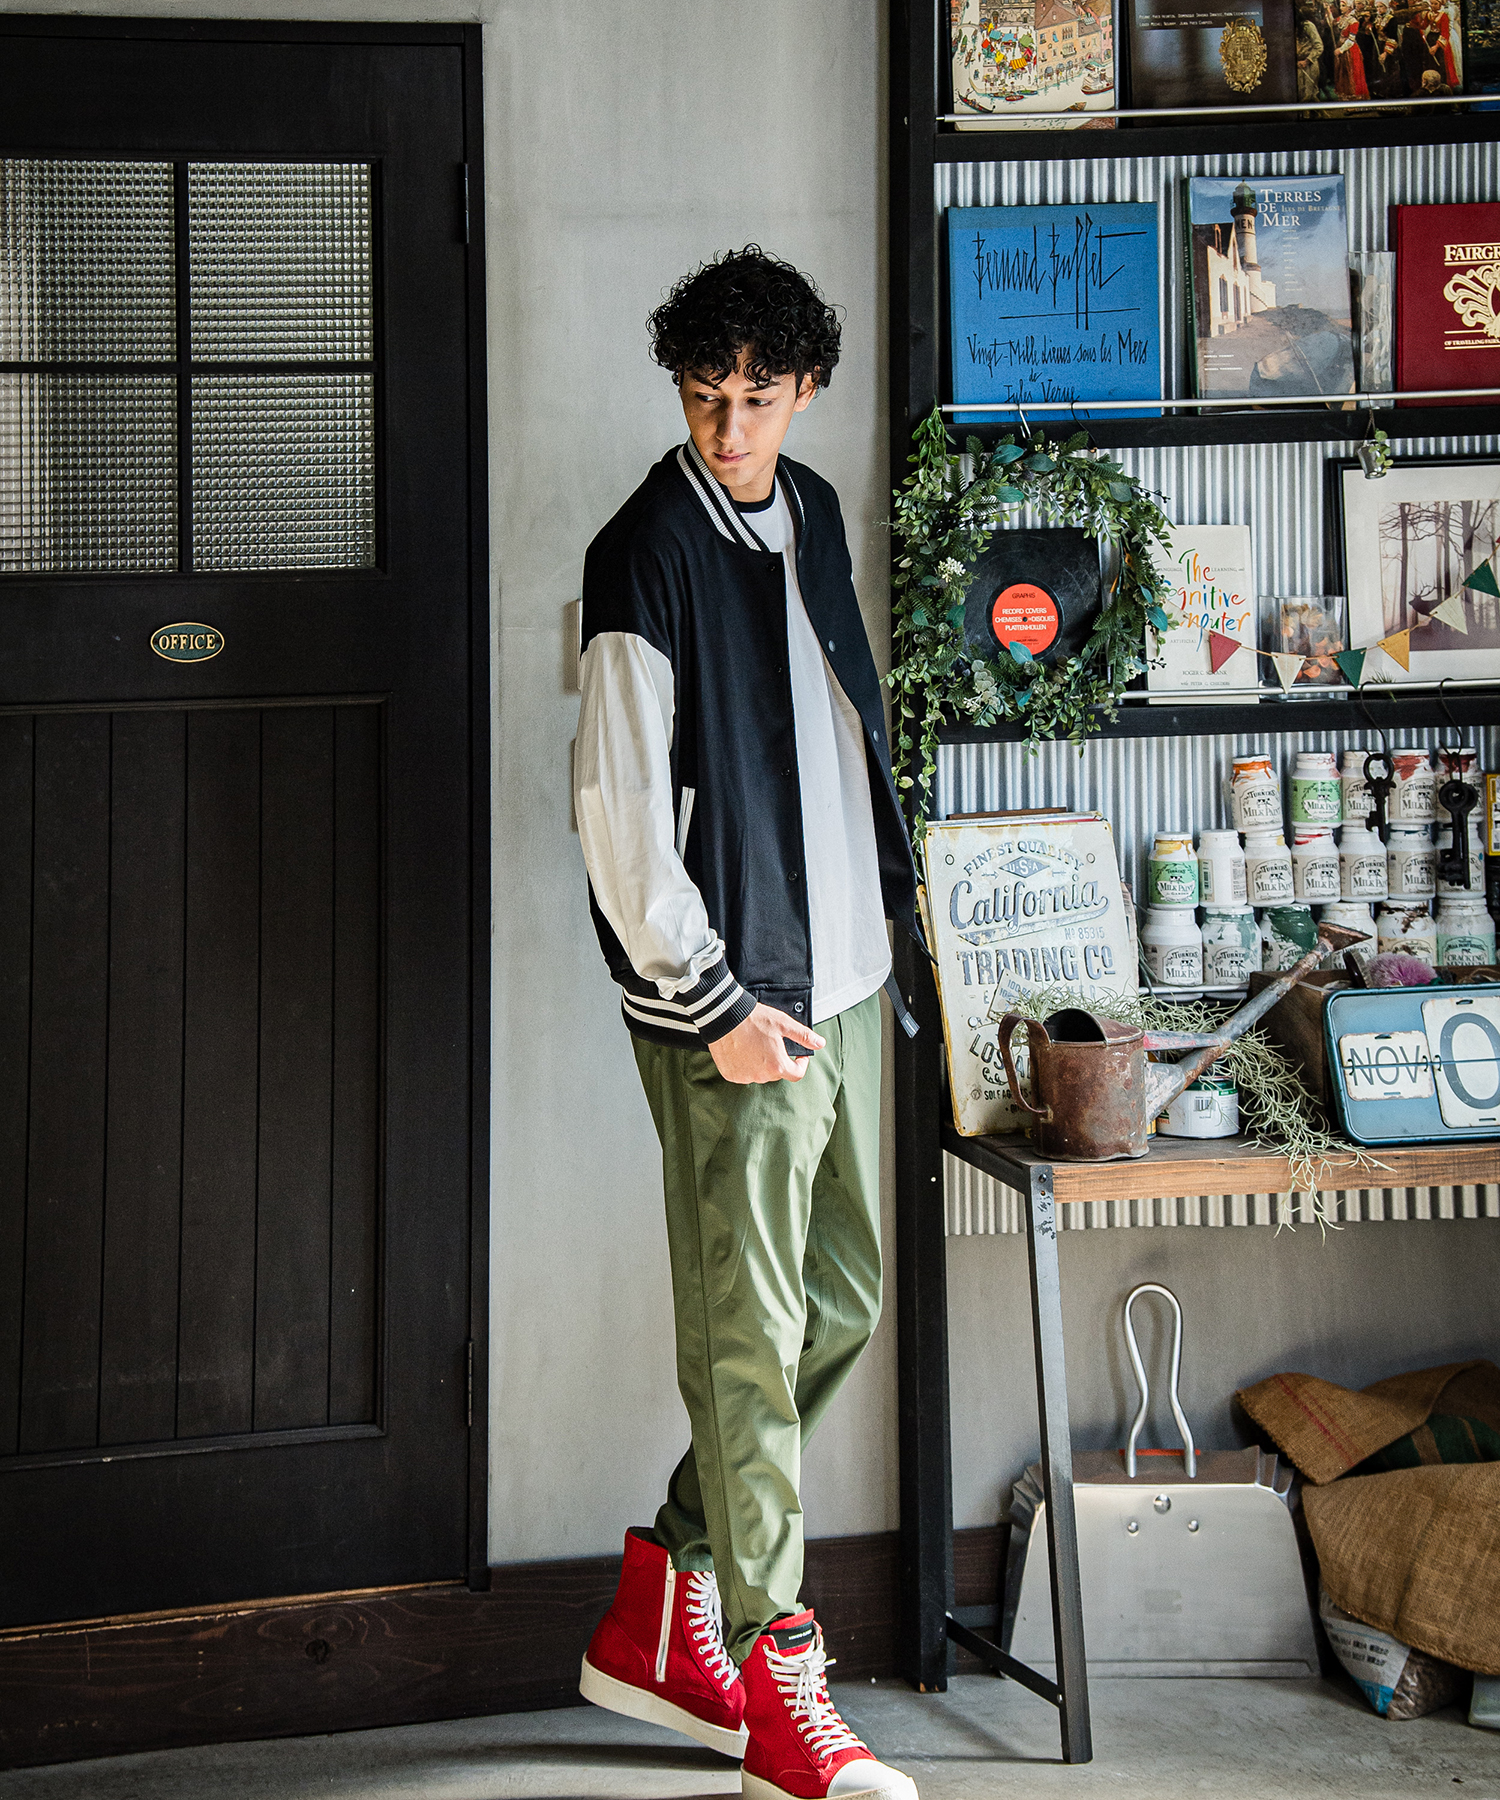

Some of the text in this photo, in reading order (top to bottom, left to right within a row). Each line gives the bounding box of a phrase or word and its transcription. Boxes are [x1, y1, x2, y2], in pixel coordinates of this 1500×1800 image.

[1258, 203, 1277, 213] DE
[1260, 188, 1322, 203] TERRES
[1262, 213, 1301, 227] MER
[1178, 548, 1216, 585] The
[1025, 607, 1047, 615] COVERS
[158, 634, 216, 651] OFFICE
[963, 840, 1085, 877] FINEST QUALITY
[950, 873, 1106, 932] California
[1077, 926, 1105, 941] 85315
[957, 946, 1079, 985] TRADING
[969, 1034, 1006, 1070] LOS
[1350, 1045, 1421, 1086] NOV
